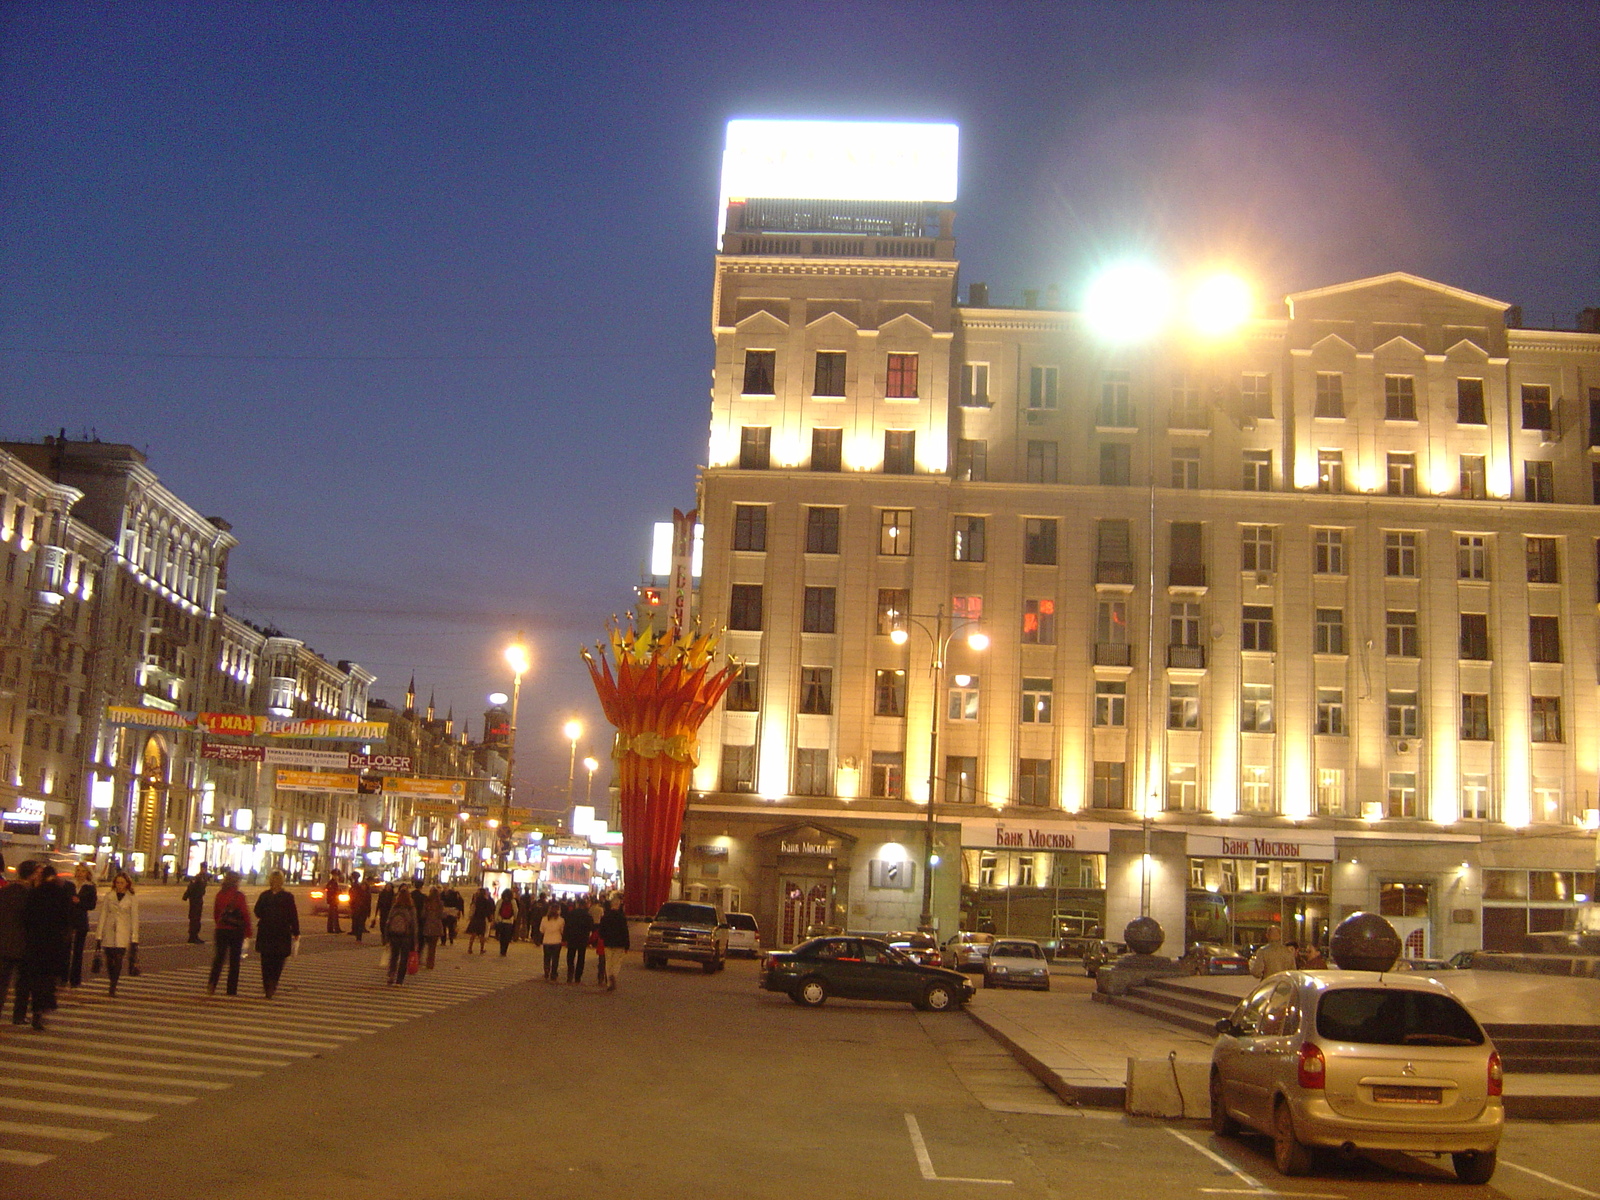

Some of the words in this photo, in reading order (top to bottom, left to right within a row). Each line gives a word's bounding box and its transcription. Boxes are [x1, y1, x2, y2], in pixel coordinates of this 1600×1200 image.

[111, 710, 187, 728] ПРАЗДНИК
[210, 717, 216, 729] 1
[221, 716, 253, 732] МАЯ
[263, 719, 314, 736] ВЕСНЫ
[318, 723, 330, 736] И
[335, 724, 385, 740] ТРУДА!
[350, 753, 365, 765] Dr.
[368, 754, 410, 767] LODER
[781, 841, 799, 853] Банк
[802, 842, 832, 854] Москвы
[996, 828, 1023, 846] Банк
[1028, 829, 1075, 849] Москвы
[1222, 837, 1249, 855] Банк
[1254, 838, 1299, 857] Москвы
